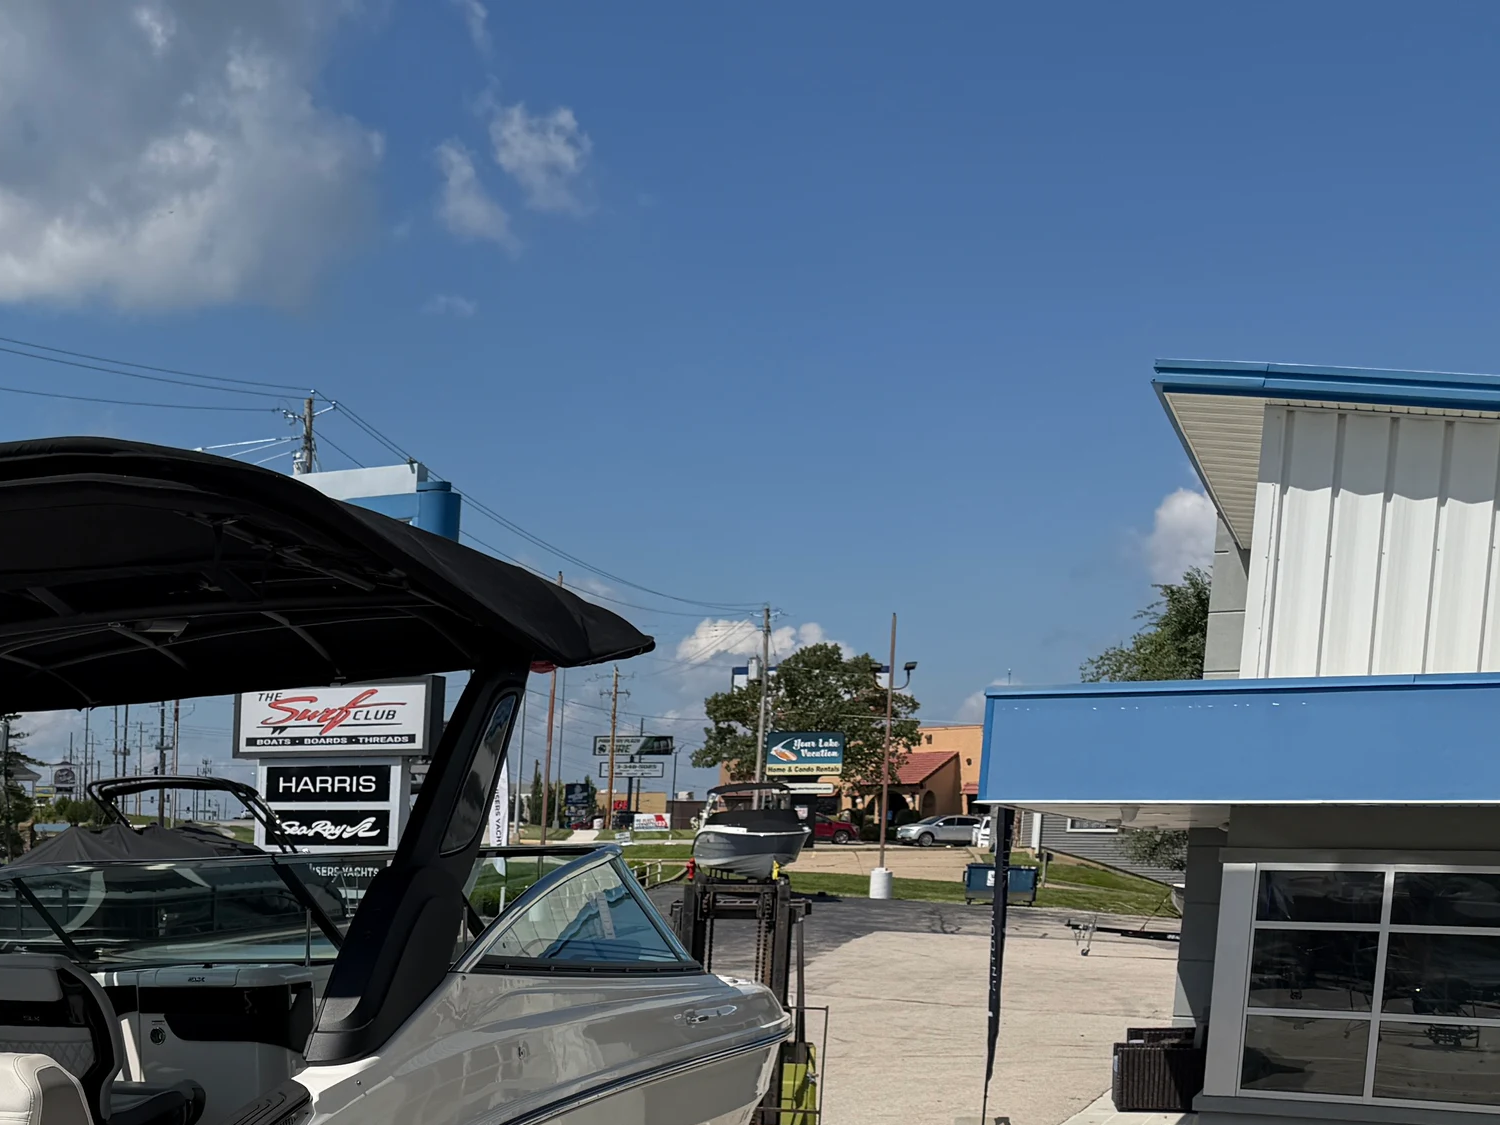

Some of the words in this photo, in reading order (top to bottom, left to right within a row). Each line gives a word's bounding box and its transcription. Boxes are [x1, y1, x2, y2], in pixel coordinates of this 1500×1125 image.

[257, 692, 283, 702] THE
[260, 688, 408, 736] Surf
[352, 709, 397, 721] CLUB
[256, 738, 292, 746] BOATS
[303, 736, 348, 745] BOARDS
[357, 735, 409, 744] THREADS
[818, 738, 840, 748] Lake
[800, 749, 839, 757] Vacation
[815, 765, 840, 773] Rentals
[278, 775, 377, 794] HARRIS
[495, 817, 503, 847] YACHT
